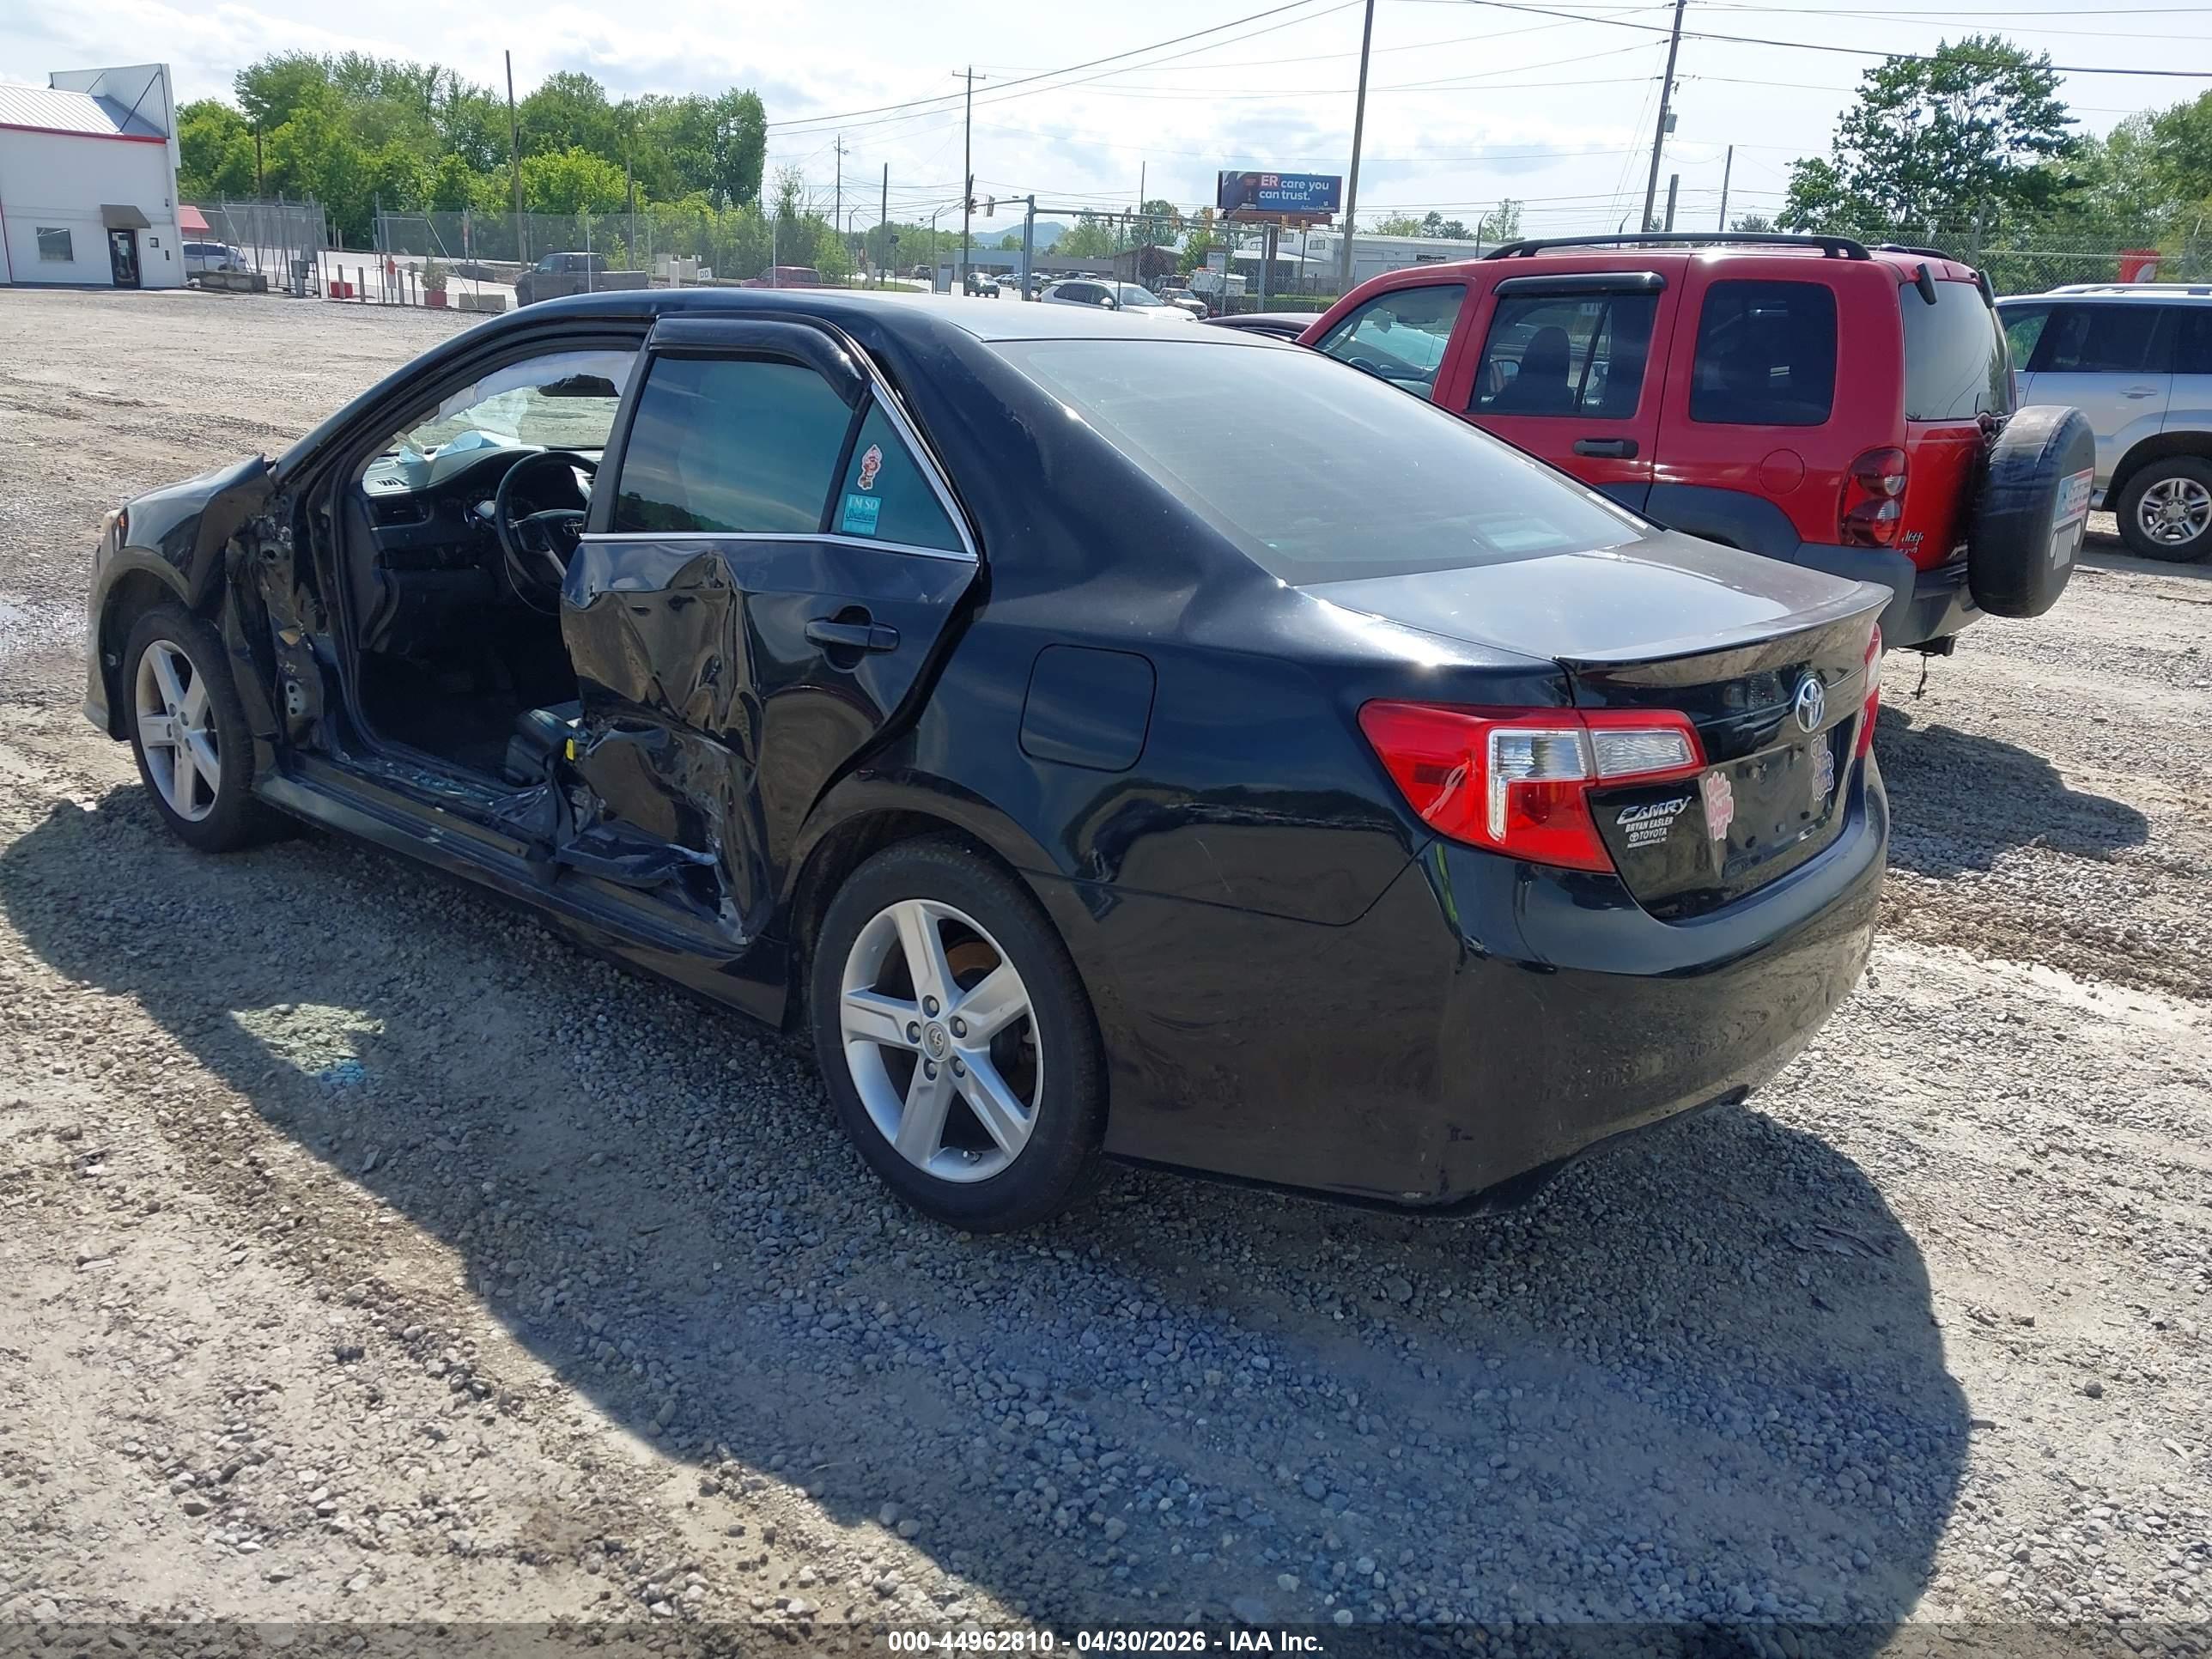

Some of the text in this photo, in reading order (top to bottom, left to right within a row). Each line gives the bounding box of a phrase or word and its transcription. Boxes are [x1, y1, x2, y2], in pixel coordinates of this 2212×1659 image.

[1261, 175, 1279, 186] ER
[1280, 179, 1306, 189] care
[1309, 182, 1329, 192] you
[1281, 191, 1310, 201] trust.
[1901, 529, 1924, 546] Jeep
[1616, 796, 1692, 824] CAMRY
[1625, 817, 1674, 833] BRYAN EASLER
[1639, 828, 1668, 840] TOYOTA
